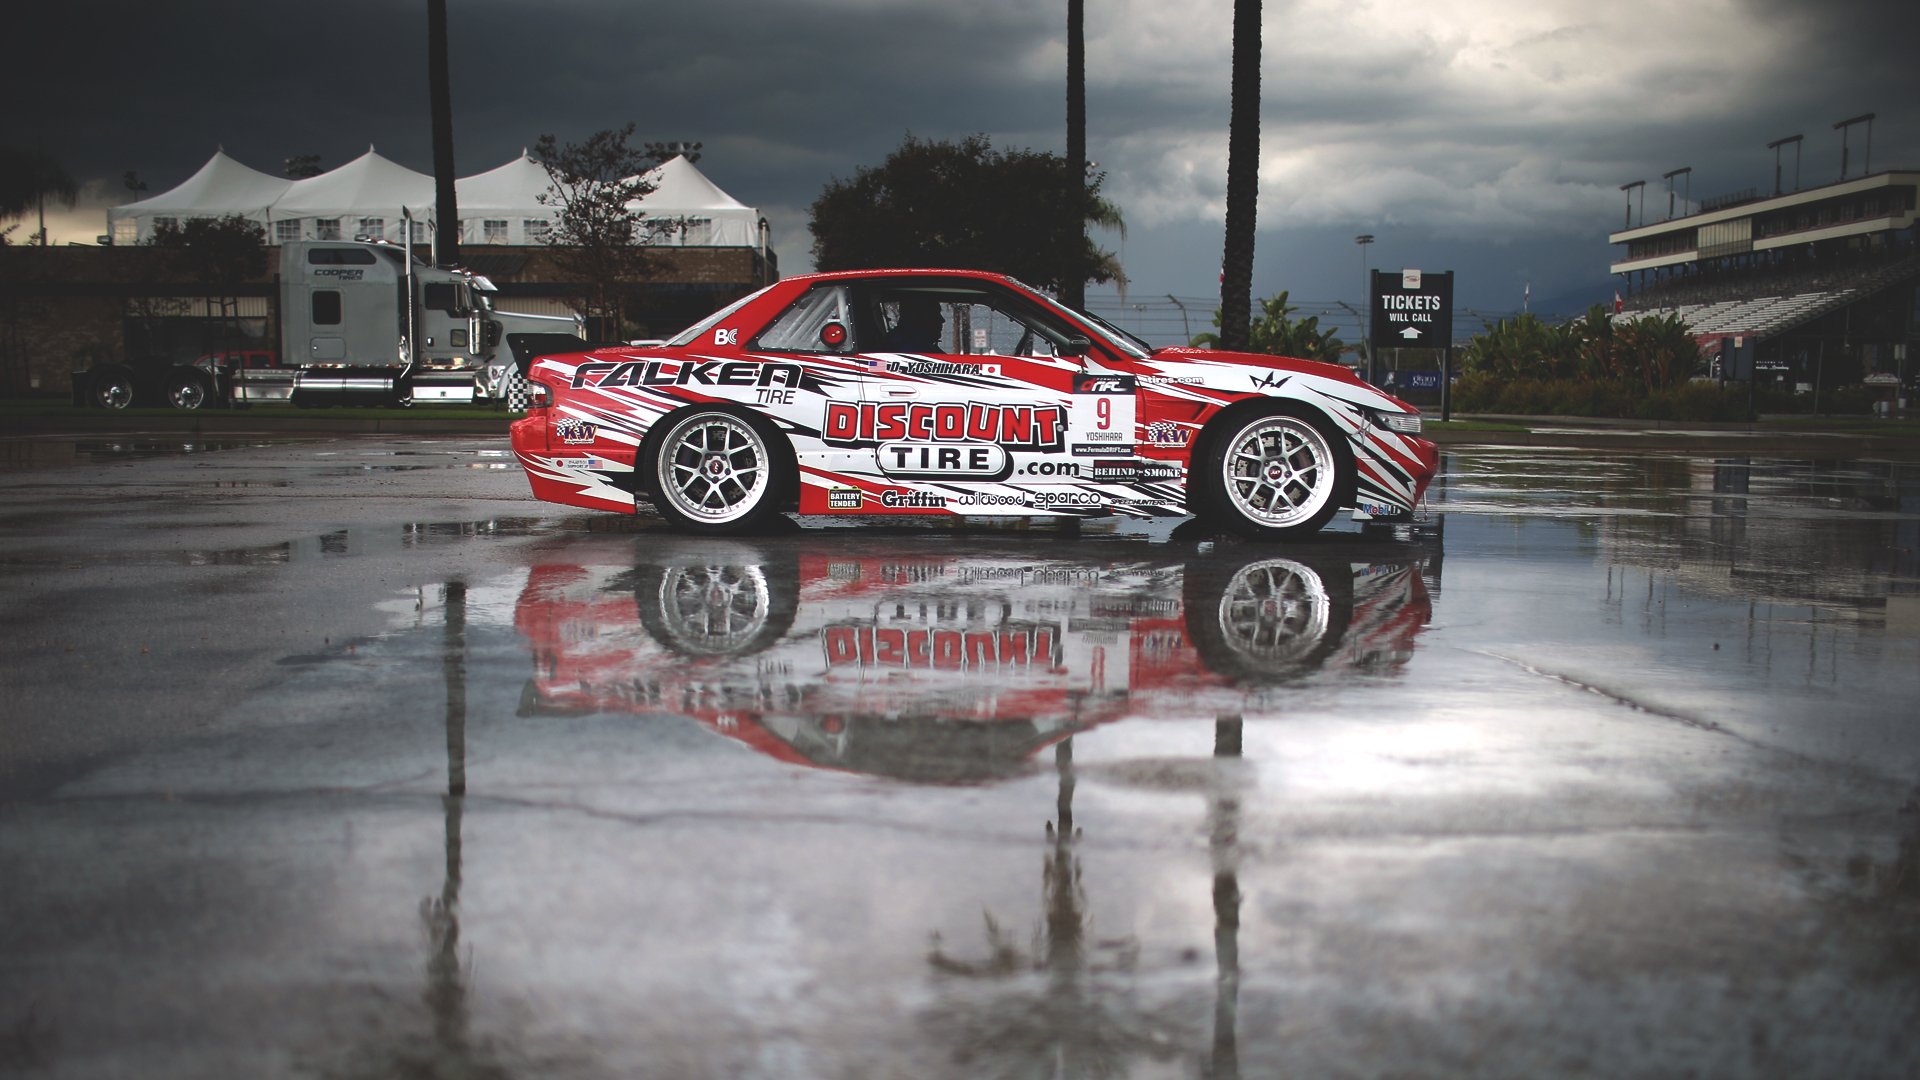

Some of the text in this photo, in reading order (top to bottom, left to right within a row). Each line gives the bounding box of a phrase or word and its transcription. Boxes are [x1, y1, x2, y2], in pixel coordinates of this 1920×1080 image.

[1382, 295, 1441, 310] TICKETS
[1389, 313, 1433, 322] WILL CALL
[571, 360, 802, 389] FALKEN
[906, 362, 981, 375] YOSHIHARA
[756, 388, 796, 404] TIRE
[1096, 397, 1111, 430] 9
[823, 400, 1066, 450] DISCOUNT
[564, 425, 599, 441] KW
[1086, 432, 1123, 441] YOSHIHARA
[1156, 429, 1193, 443] KW
[890, 447, 1080, 477] TIRE .com
[1094, 467, 1136, 476] BEHIND
[1144, 468, 1181, 477] SMOKE
[881, 490, 948, 508] Griffin
[958, 492, 1026, 507] wilwood
[1034, 491, 1102, 508] sparco
[1362, 504, 1389, 515] Mobil
